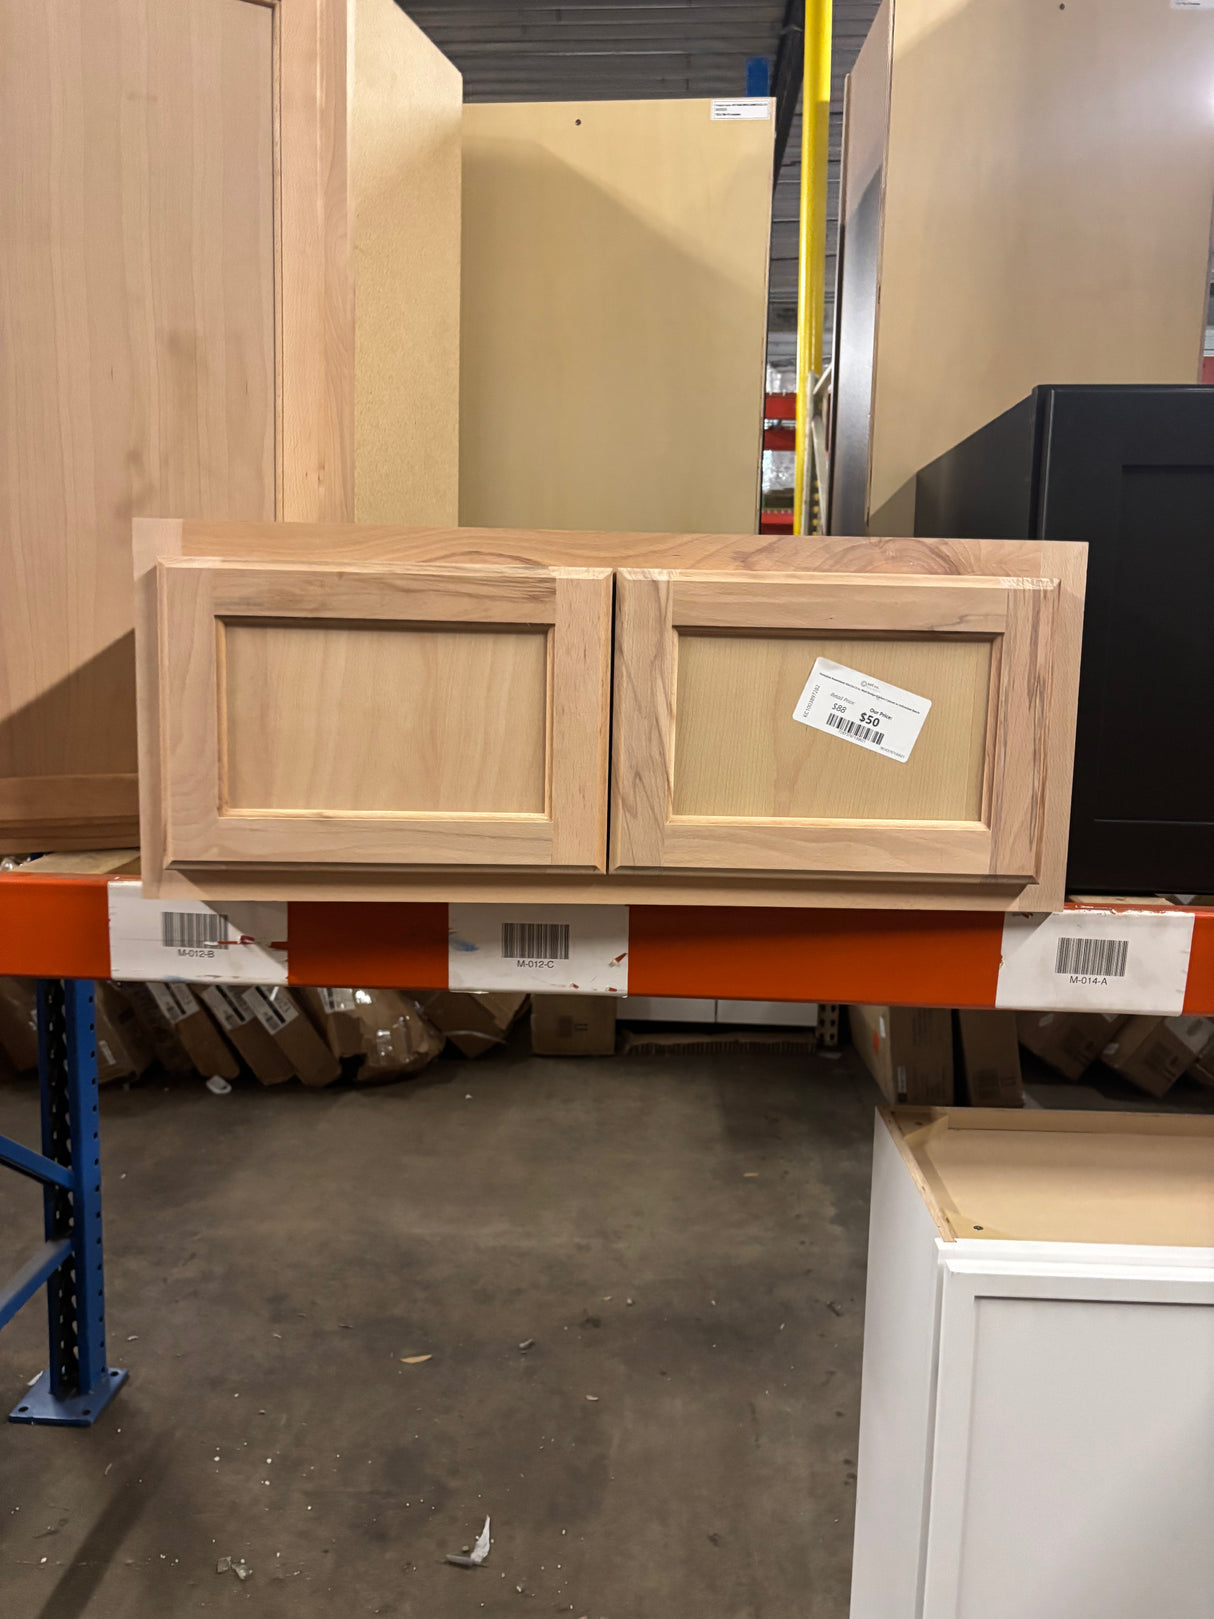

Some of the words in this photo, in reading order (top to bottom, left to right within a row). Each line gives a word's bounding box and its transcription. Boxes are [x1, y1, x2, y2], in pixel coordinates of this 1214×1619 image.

[831, 702, 847, 714] $88
[869, 707, 880, 715] Our
[859, 712, 880, 727] $50
[177, 948, 215, 958] M-012-B
[516, 959, 555, 969] M-012-C
[1069, 975, 1108, 985] M-014-A
